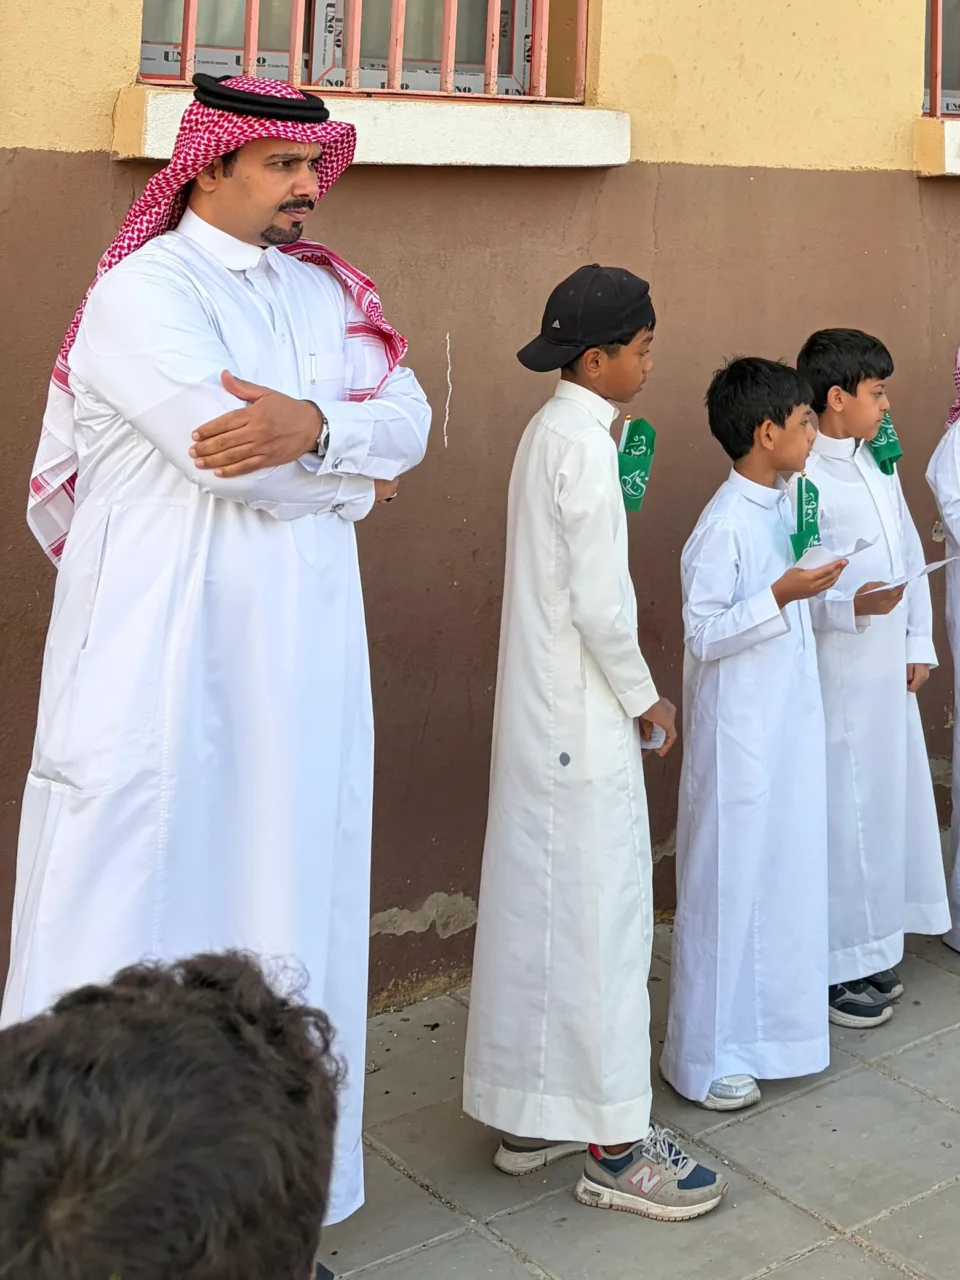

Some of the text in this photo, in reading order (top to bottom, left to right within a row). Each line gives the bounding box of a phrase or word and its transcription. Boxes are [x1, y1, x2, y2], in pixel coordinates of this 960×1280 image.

[325, 2, 336, 35] UNO
[334, 17, 343, 49] UNO
[235, 55, 267, 68] UO
[523, 34, 532, 64] UNO
[324, 78, 346, 89] NO
